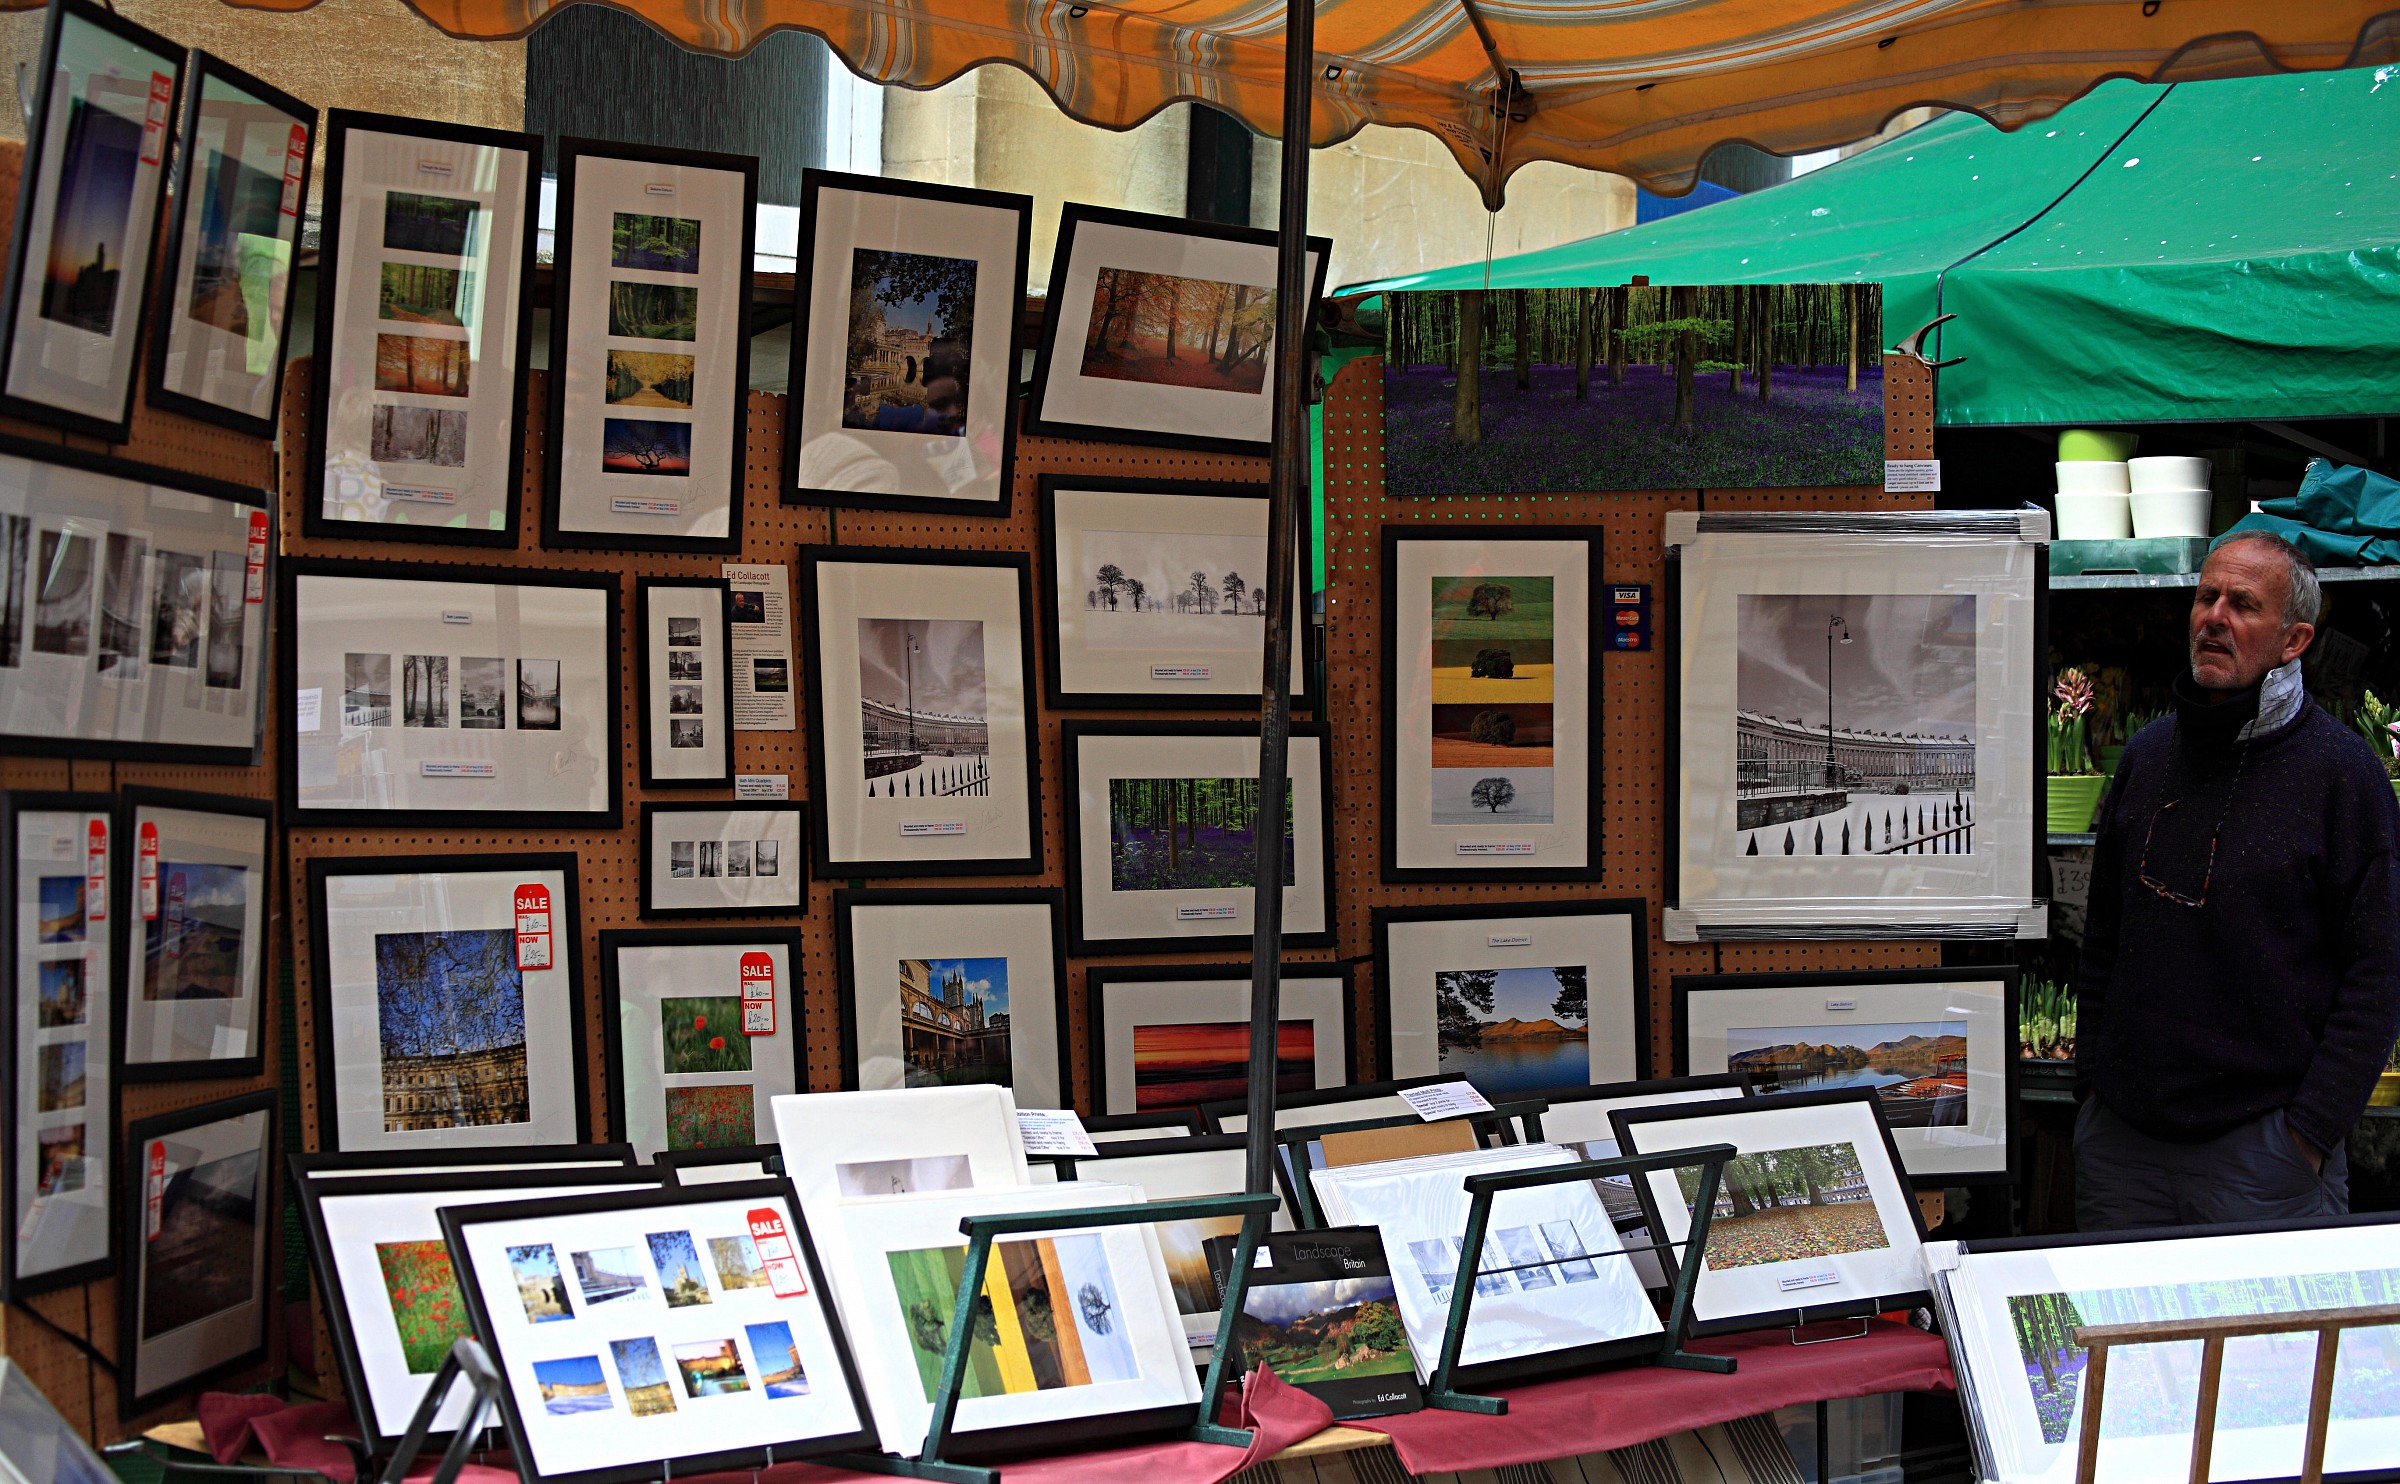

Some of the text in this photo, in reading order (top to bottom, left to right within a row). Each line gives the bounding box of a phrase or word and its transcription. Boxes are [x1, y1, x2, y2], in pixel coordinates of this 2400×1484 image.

[250, 526, 266, 539] SALE
[727, 571, 770, 580] Ed Collacott
[517, 898, 548, 910] SALE
[743, 966, 771, 977] SALE
[752, 1220, 784, 1236] SALE
[1294, 1243, 1351, 1262] Landscape
[1343, 1258, 1366, 1270] Britain
[1377, 1394, 1384, 1402] Ed
[1385, 1393, 1407, 1401] Collacott
